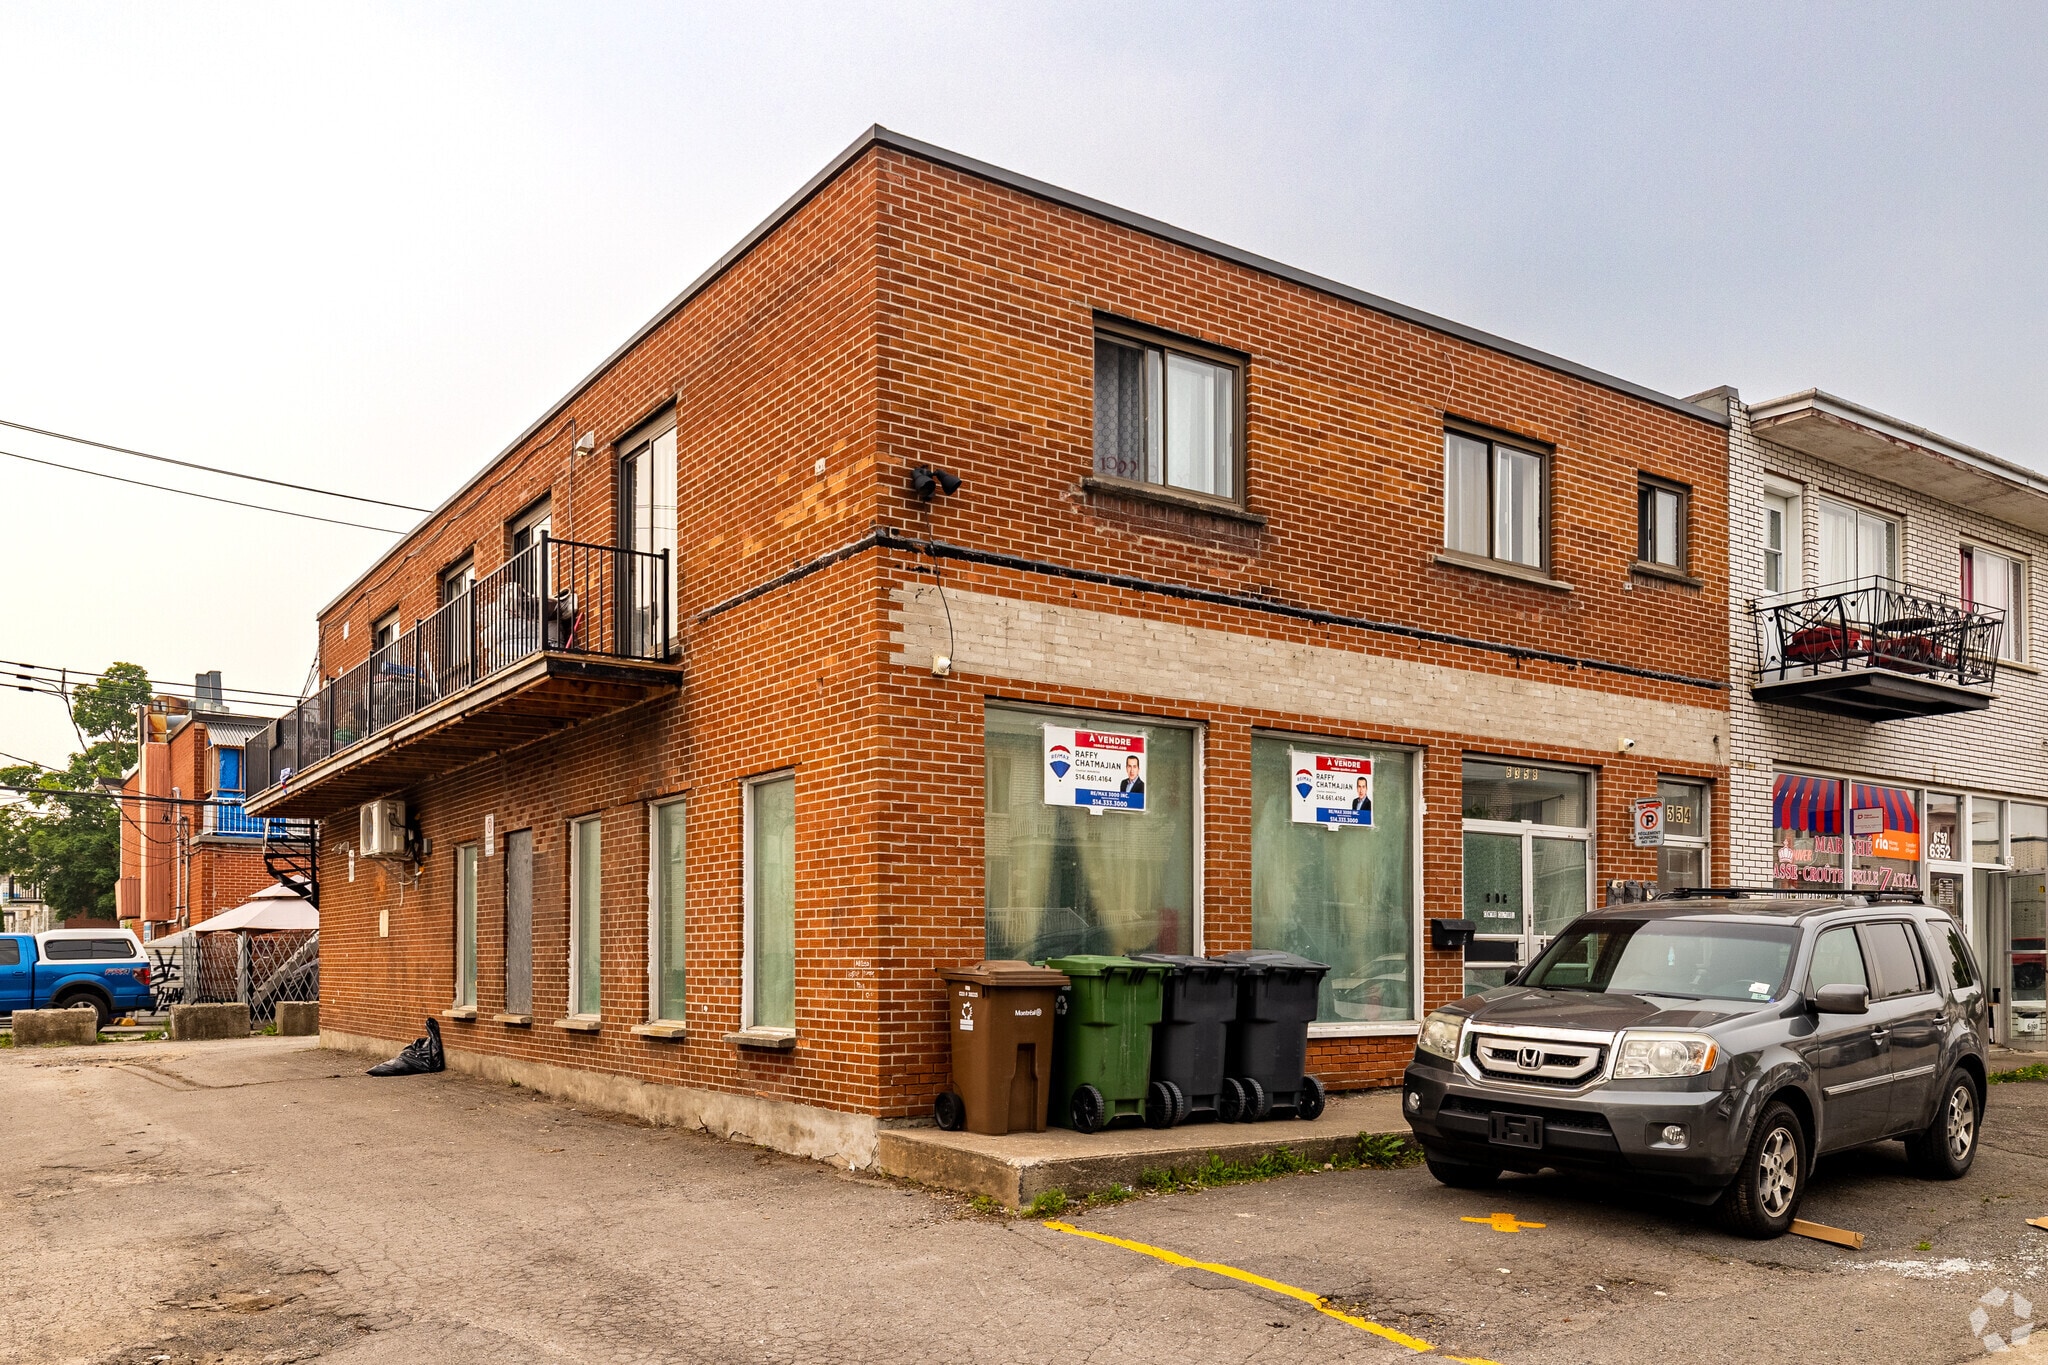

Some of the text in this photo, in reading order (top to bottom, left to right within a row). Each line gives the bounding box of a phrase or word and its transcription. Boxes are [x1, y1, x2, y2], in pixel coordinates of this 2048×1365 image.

[1098, 736, 1131, 746] VENDRE
[1075, 750, 1098, 758] RAFFY
[1075, 760, 1121, 770] CHATMAJIAN
[1334, 760, 1360, 768] VENDRE
[1075, 774, 1112, 782] 514.661.4164
[1316, 781, 1353, 790] CHATMAJIAN
[1092, 799, 1128, 807] 514.333.3000
[1875, 833, 1889, 850] ria
[1929, 843, 1951, 858] 6352
[1015, 1009, 1036, 1017] Montréal
